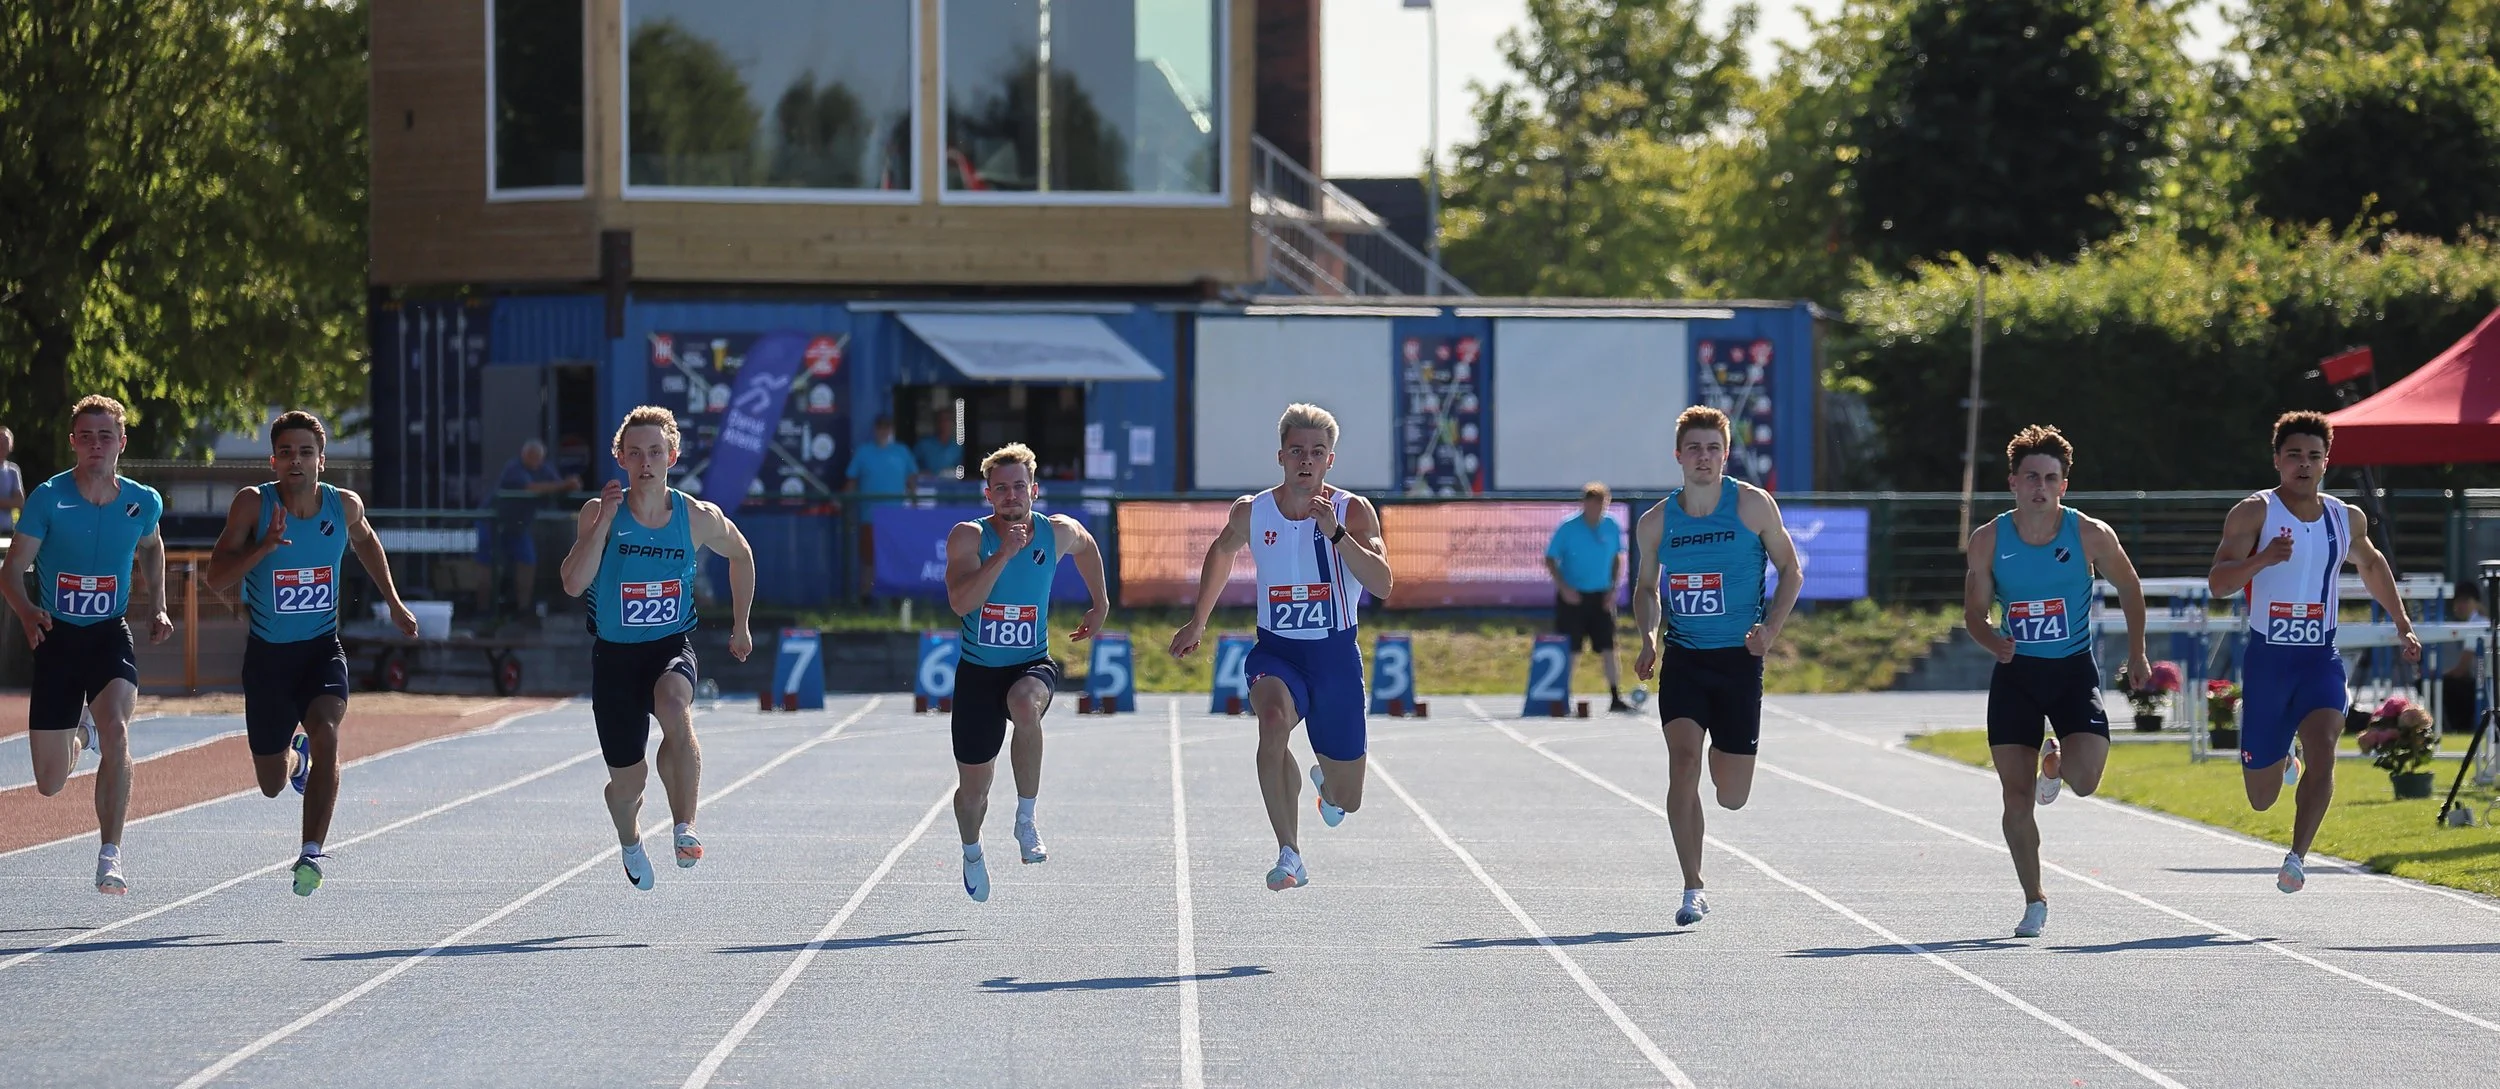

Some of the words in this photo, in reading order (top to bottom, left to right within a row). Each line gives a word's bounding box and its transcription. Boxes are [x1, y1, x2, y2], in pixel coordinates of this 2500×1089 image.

[618, 543, 686, 560] SPARTA
[1670, 530, 1736, 548] SPARTA
[62, 590, 110, 614] 170
[279, 584, 330, 610] 222
[626, 597, 676, 623] 223
[1674, 590, 1719, 613] 175
[1275, 601, 1327, 629] 274
[2015, 615, 2062, 640] 174
[985, 620, 1032, 646] 180
[2271, 618, 2321, 643] 256
[781, 642, 818, 694] 7
[920, 643, 955, 697] 6
[1092, 645, 1129, 698] 5
[1215, 645, 1247, 699] 4
[1376, 645, 1410, 699] 3
[1530, 646, 1567, 700] 2
